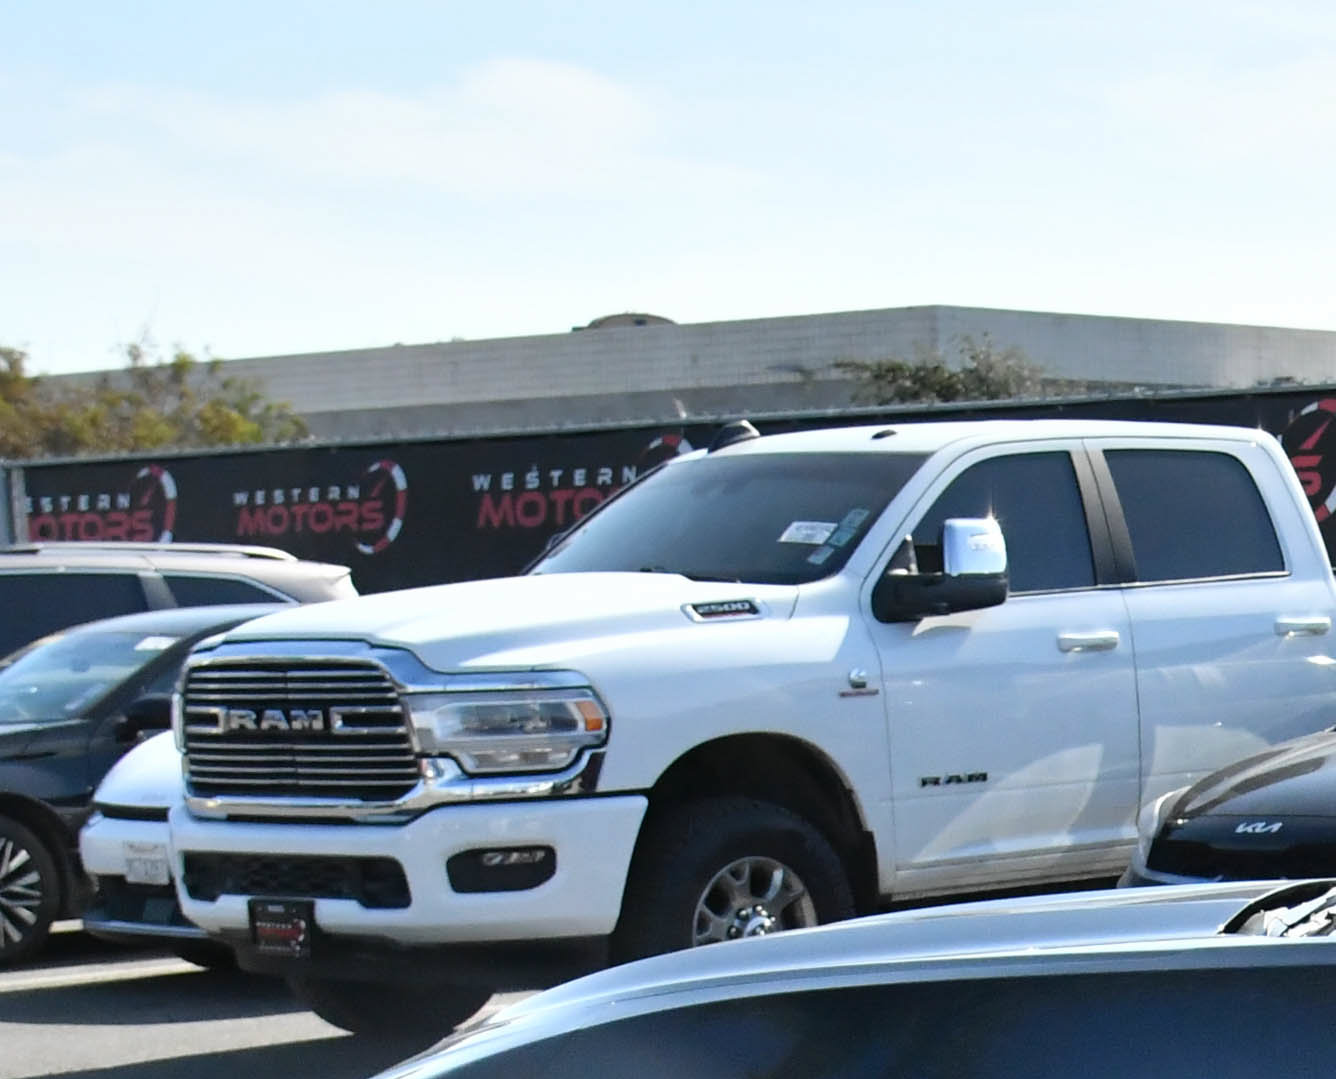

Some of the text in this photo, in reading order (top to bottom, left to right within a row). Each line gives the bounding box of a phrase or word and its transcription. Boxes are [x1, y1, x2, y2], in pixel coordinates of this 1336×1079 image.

[472, 465, 638, 492] WESTERN
[25, 492, 131, 513] ESTERN
[232, 485, 361, 505] WESTERN
[236, 500, 385, 536] MOTORS
[477, 488, 618, 528] MOTO
[28, 509, 154, 542] OTORS
[228, 708, 325, 731] RAM
[919, 771, 988, 787] RAM
